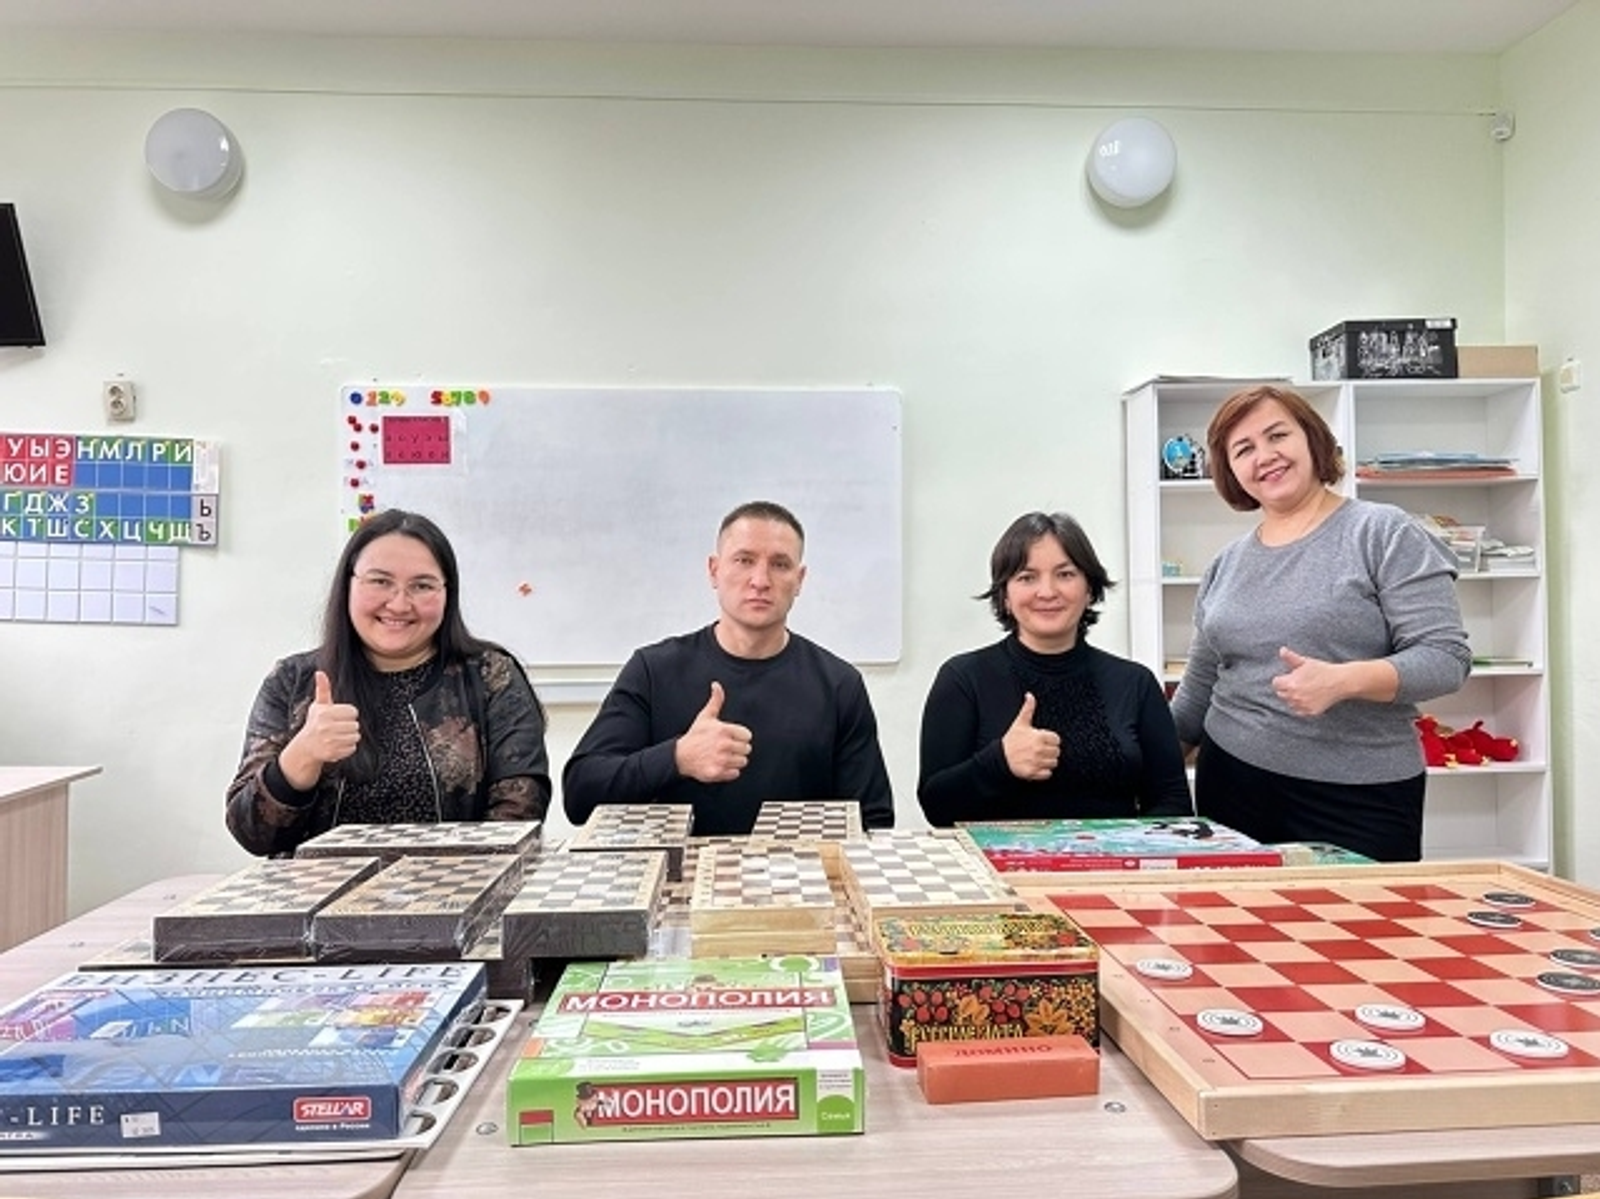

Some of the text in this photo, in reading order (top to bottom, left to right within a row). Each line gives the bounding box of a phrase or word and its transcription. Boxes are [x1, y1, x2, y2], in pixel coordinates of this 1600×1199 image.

[564, 990, 832, 1011] МОНОПОЛИЯ
[300, 1101, 365, 1118] STELLAR
[596, 1084, 795, 1119] МОНОПОЛИЯ
[0, 1105, 105, 1126] -LIFE
